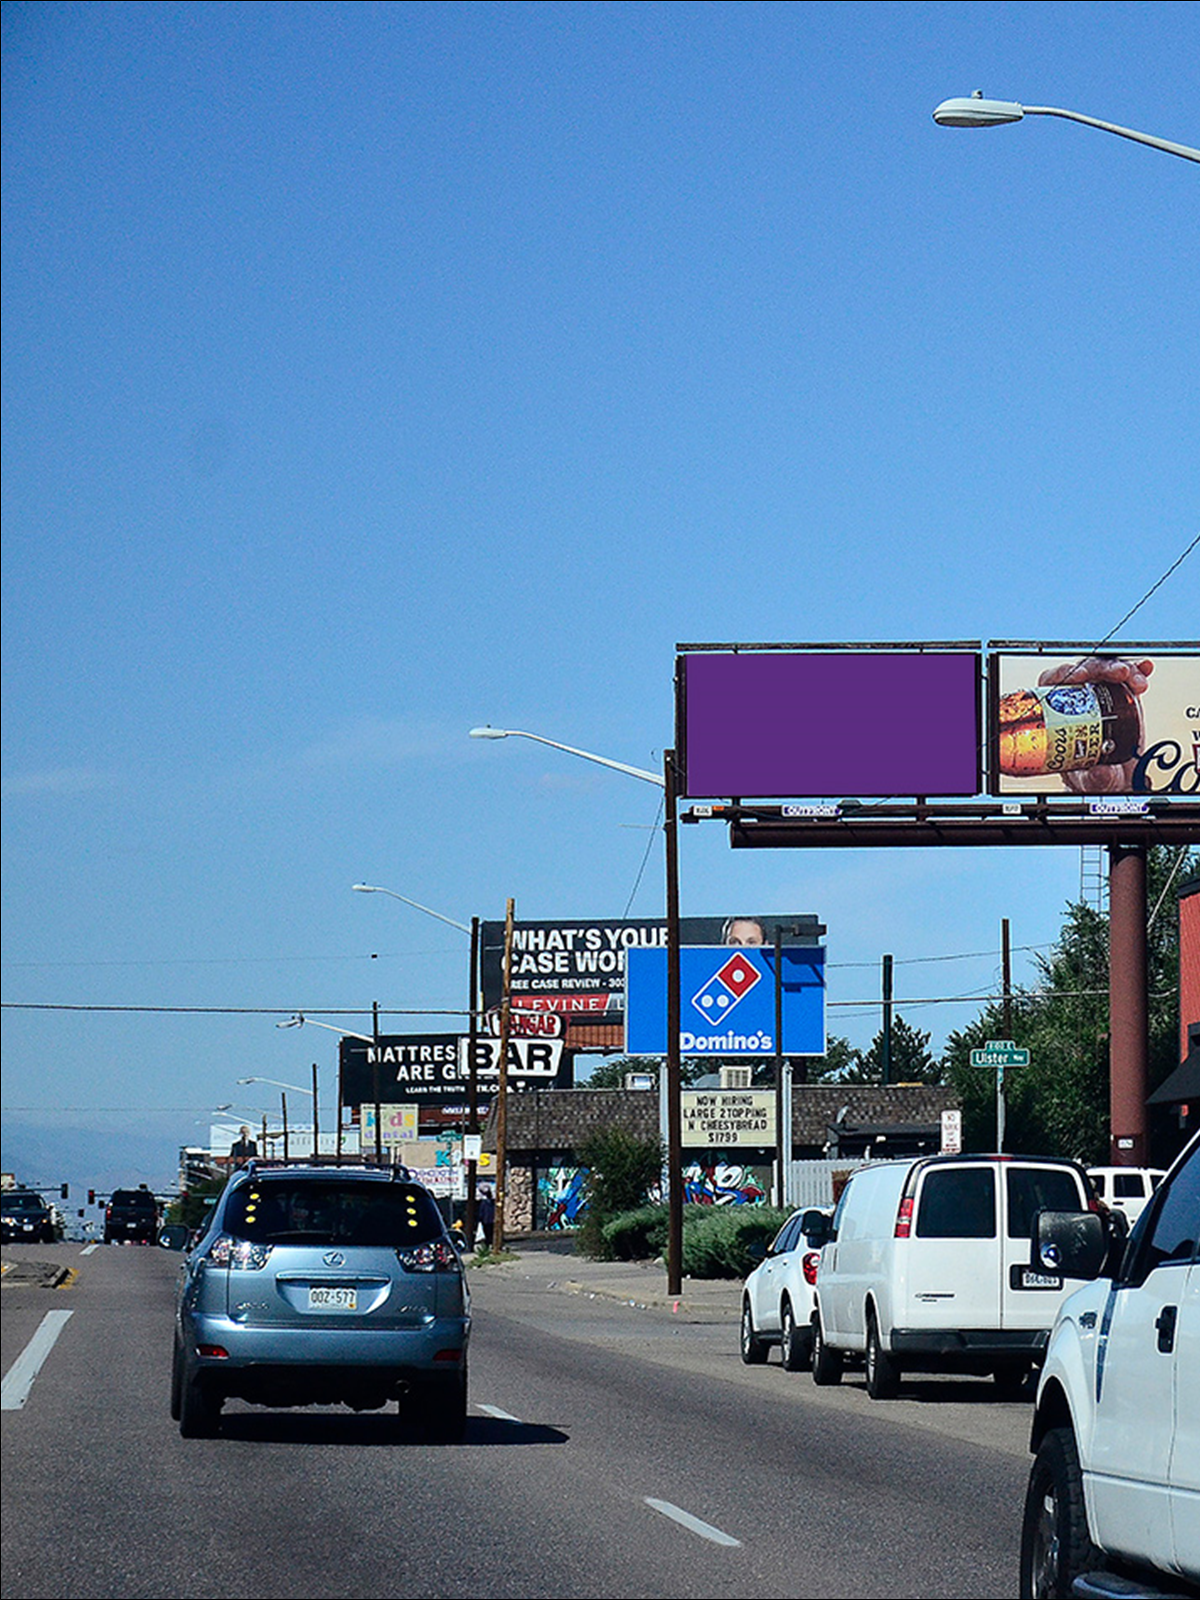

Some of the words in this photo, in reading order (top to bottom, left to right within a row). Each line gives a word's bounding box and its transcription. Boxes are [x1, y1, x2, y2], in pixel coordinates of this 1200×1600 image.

[501, 952, 569, 974] CASE
[510, 979, 529, 989] REE
[531, 978, 559, 989] CASE
[561, 978, 600, 989] REVIEW
[679, 1030, 773, 1051] Domino's
[367, 1045, 456, 1063] MATTRES
[473, 1043, 552, 1072] BAR
[975, 1052, 1009, 1064] Ulster
[397, 1065, 435, 1081] ARE
[696, 1096, 717, 1106] NOW
[721, 1095, 753, 1106] HIRING
[366, 1112, 414, 1127] kds
[683, 1108, 716, 1118] LARGE
[688, 1120, 695, 1130] N
[700, 1120, 768, 1131] CHEESYBREAD
[364, 1129, 414, 1139] dntal
